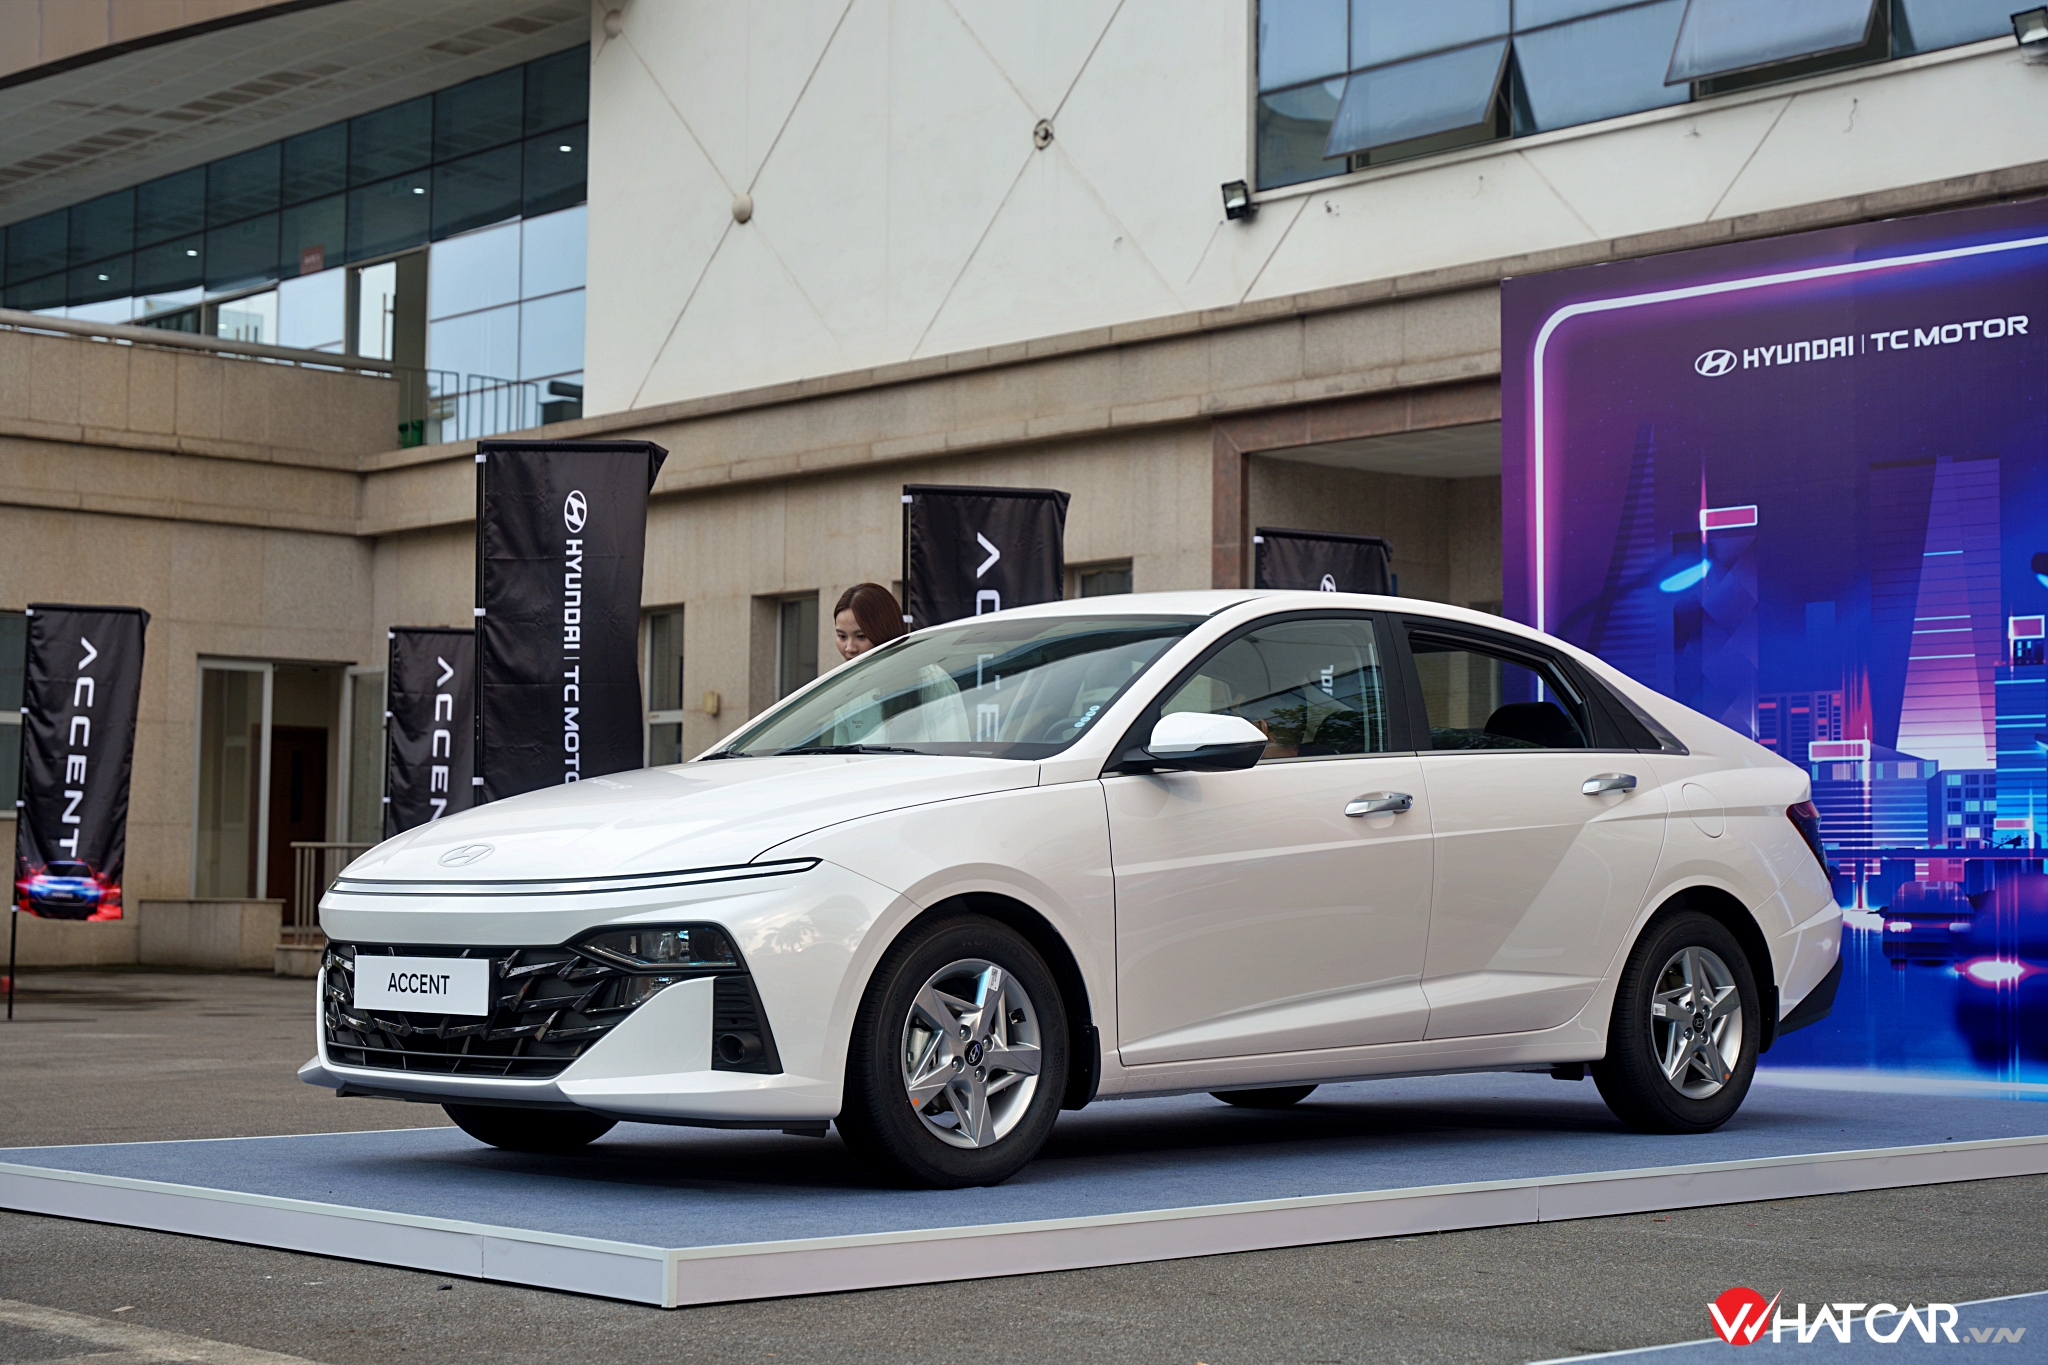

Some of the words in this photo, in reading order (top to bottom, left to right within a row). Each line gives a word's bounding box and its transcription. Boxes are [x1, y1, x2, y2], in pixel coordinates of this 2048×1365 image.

[1743, 335, 1854, 369] HYUNDAI
[1870, 329, 1909, 352] TC
[1914, 315, 2029, 347] MOTOR
[563, 539, 583, 649] HYUNDAI
[563, 665, 580, 702] TC
[59, 636, 98, 858] ACCENT
[429, 655, 454, 821] ACCEN
[387, 972, 450, 994] ACCENT
